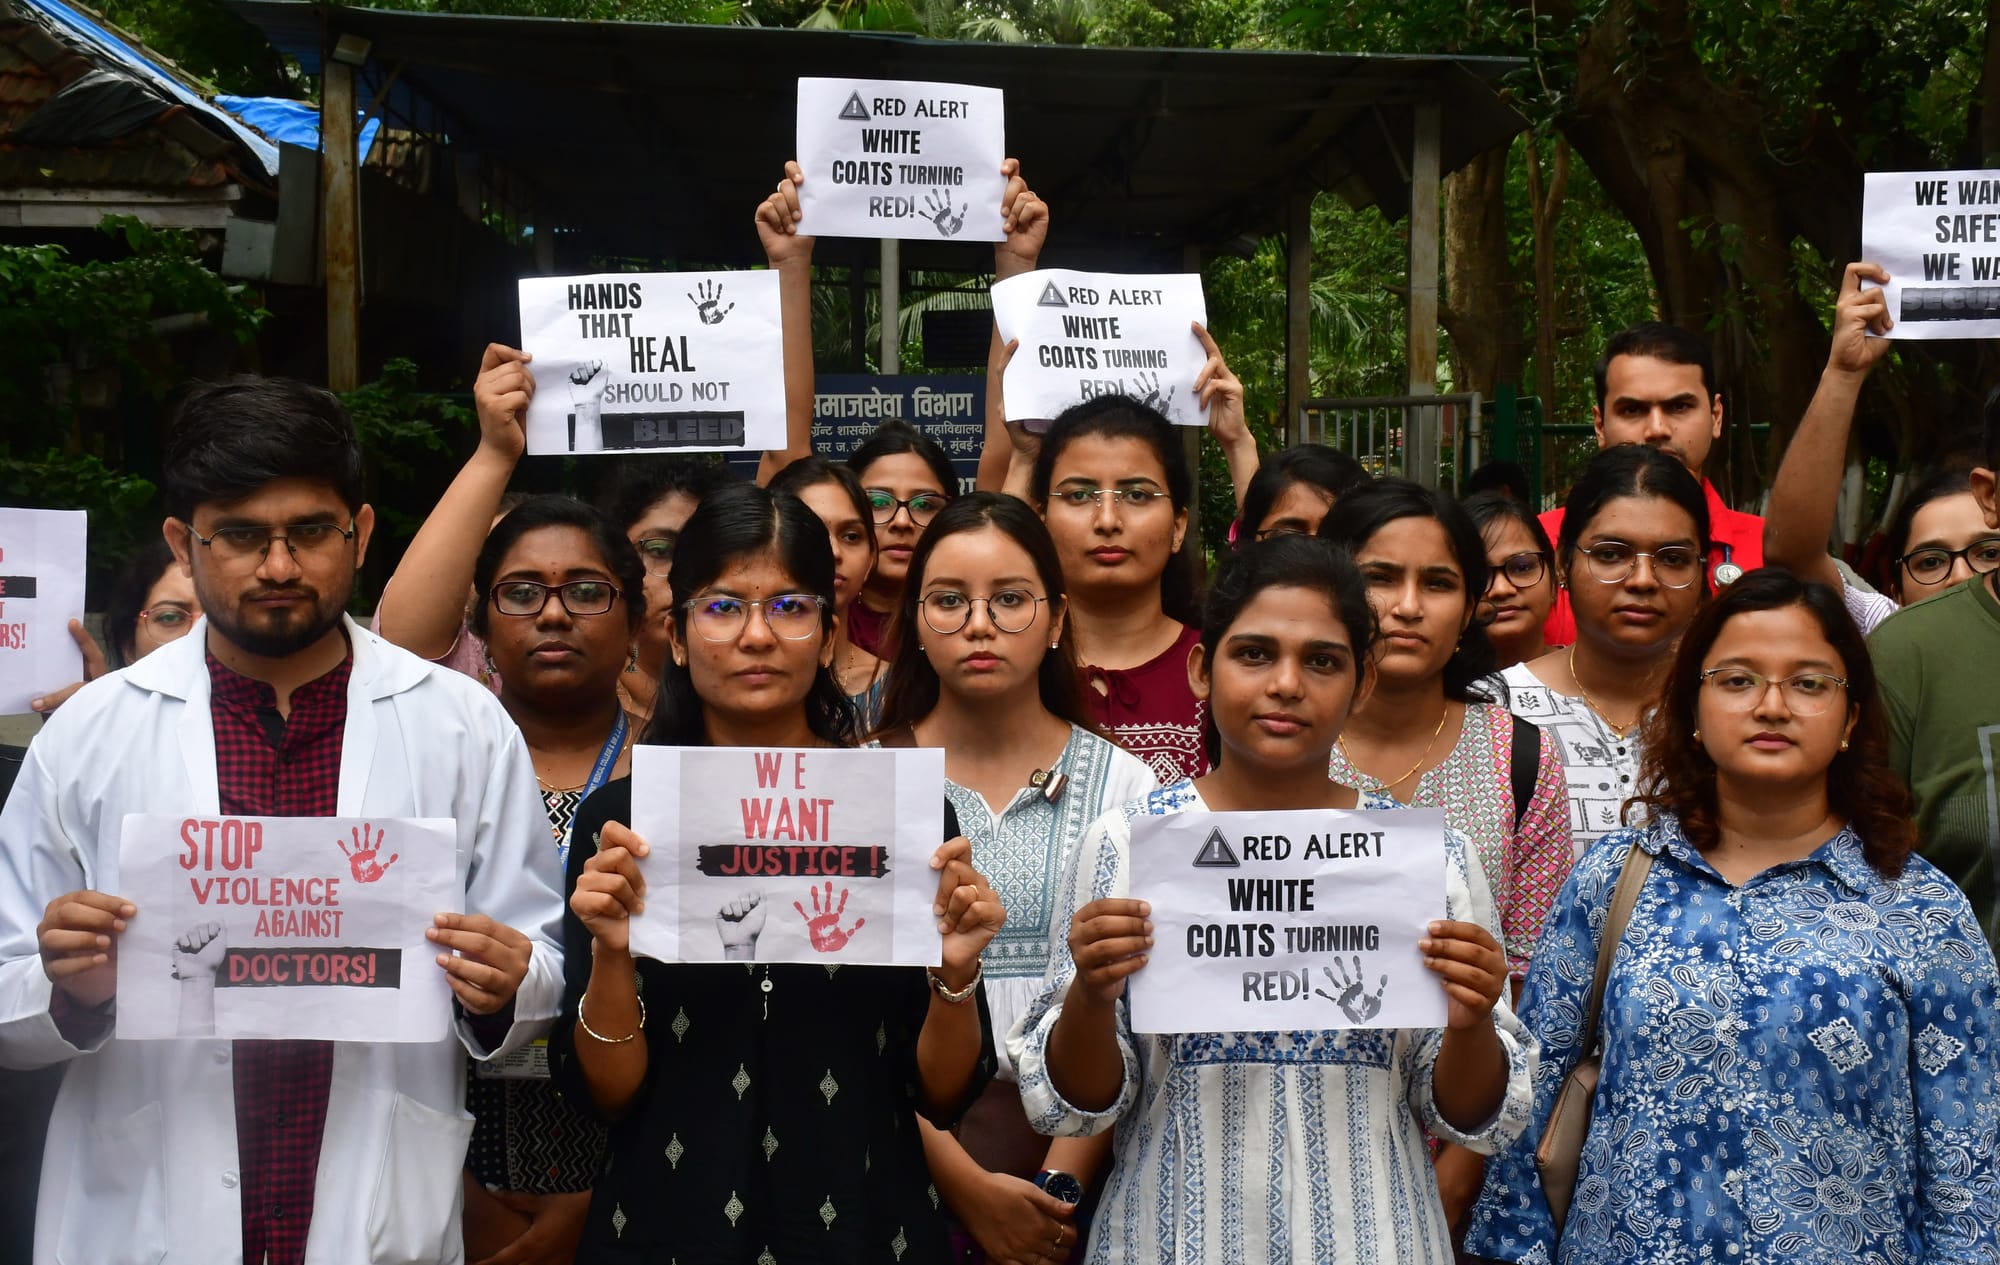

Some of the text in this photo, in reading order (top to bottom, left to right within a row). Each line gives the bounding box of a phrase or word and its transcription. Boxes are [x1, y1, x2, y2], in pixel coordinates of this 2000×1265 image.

[873, 98, 969, 119] RED ALERT
[862, 129, 921, 154] WHITE
[832, 160, 963, 186] COATS TURNING
[869, 196, 915, 218] RED!
[1915, 181, 1948, 206] WE
[1936, 214, 2000, 243] SAFE
[1923, 253, 1960, 281] WE
[567, 282, 642, 310] HANDS
[1068, 286, 1163, 306] RED ALERT
[578, 313, 633, 338] THAT
[1062, 315, 1121, 340] WHITE
[630, 335, 696, 373] HEAL
[1038, 345, 1168, 369] COATS TURNING
[604, 381, 730, 404] SHOULD NOT
[912, 386, 974, 418] विभाग
[633, 417, 744, 441] BLEED
[925, 420, 983, 437] महाविद्यालय
[817, 442, 832, 454] सर
[740, 797, 834, 842] WANT
[179, 818, 263, 871] STOP
[1243, 831, 1385, 861] RED ALERT
[190, 877, 340, 907] VIOLENCE
[1227, 878, 1315, 912] WHITE
[254, 909, 344, 938] AGAINST
[1186, 923, 1379, 958] COATS TURNING
[228, 953, 376, 984] DOCTORS!
[1242, 967, 1309, 1002] RED!
